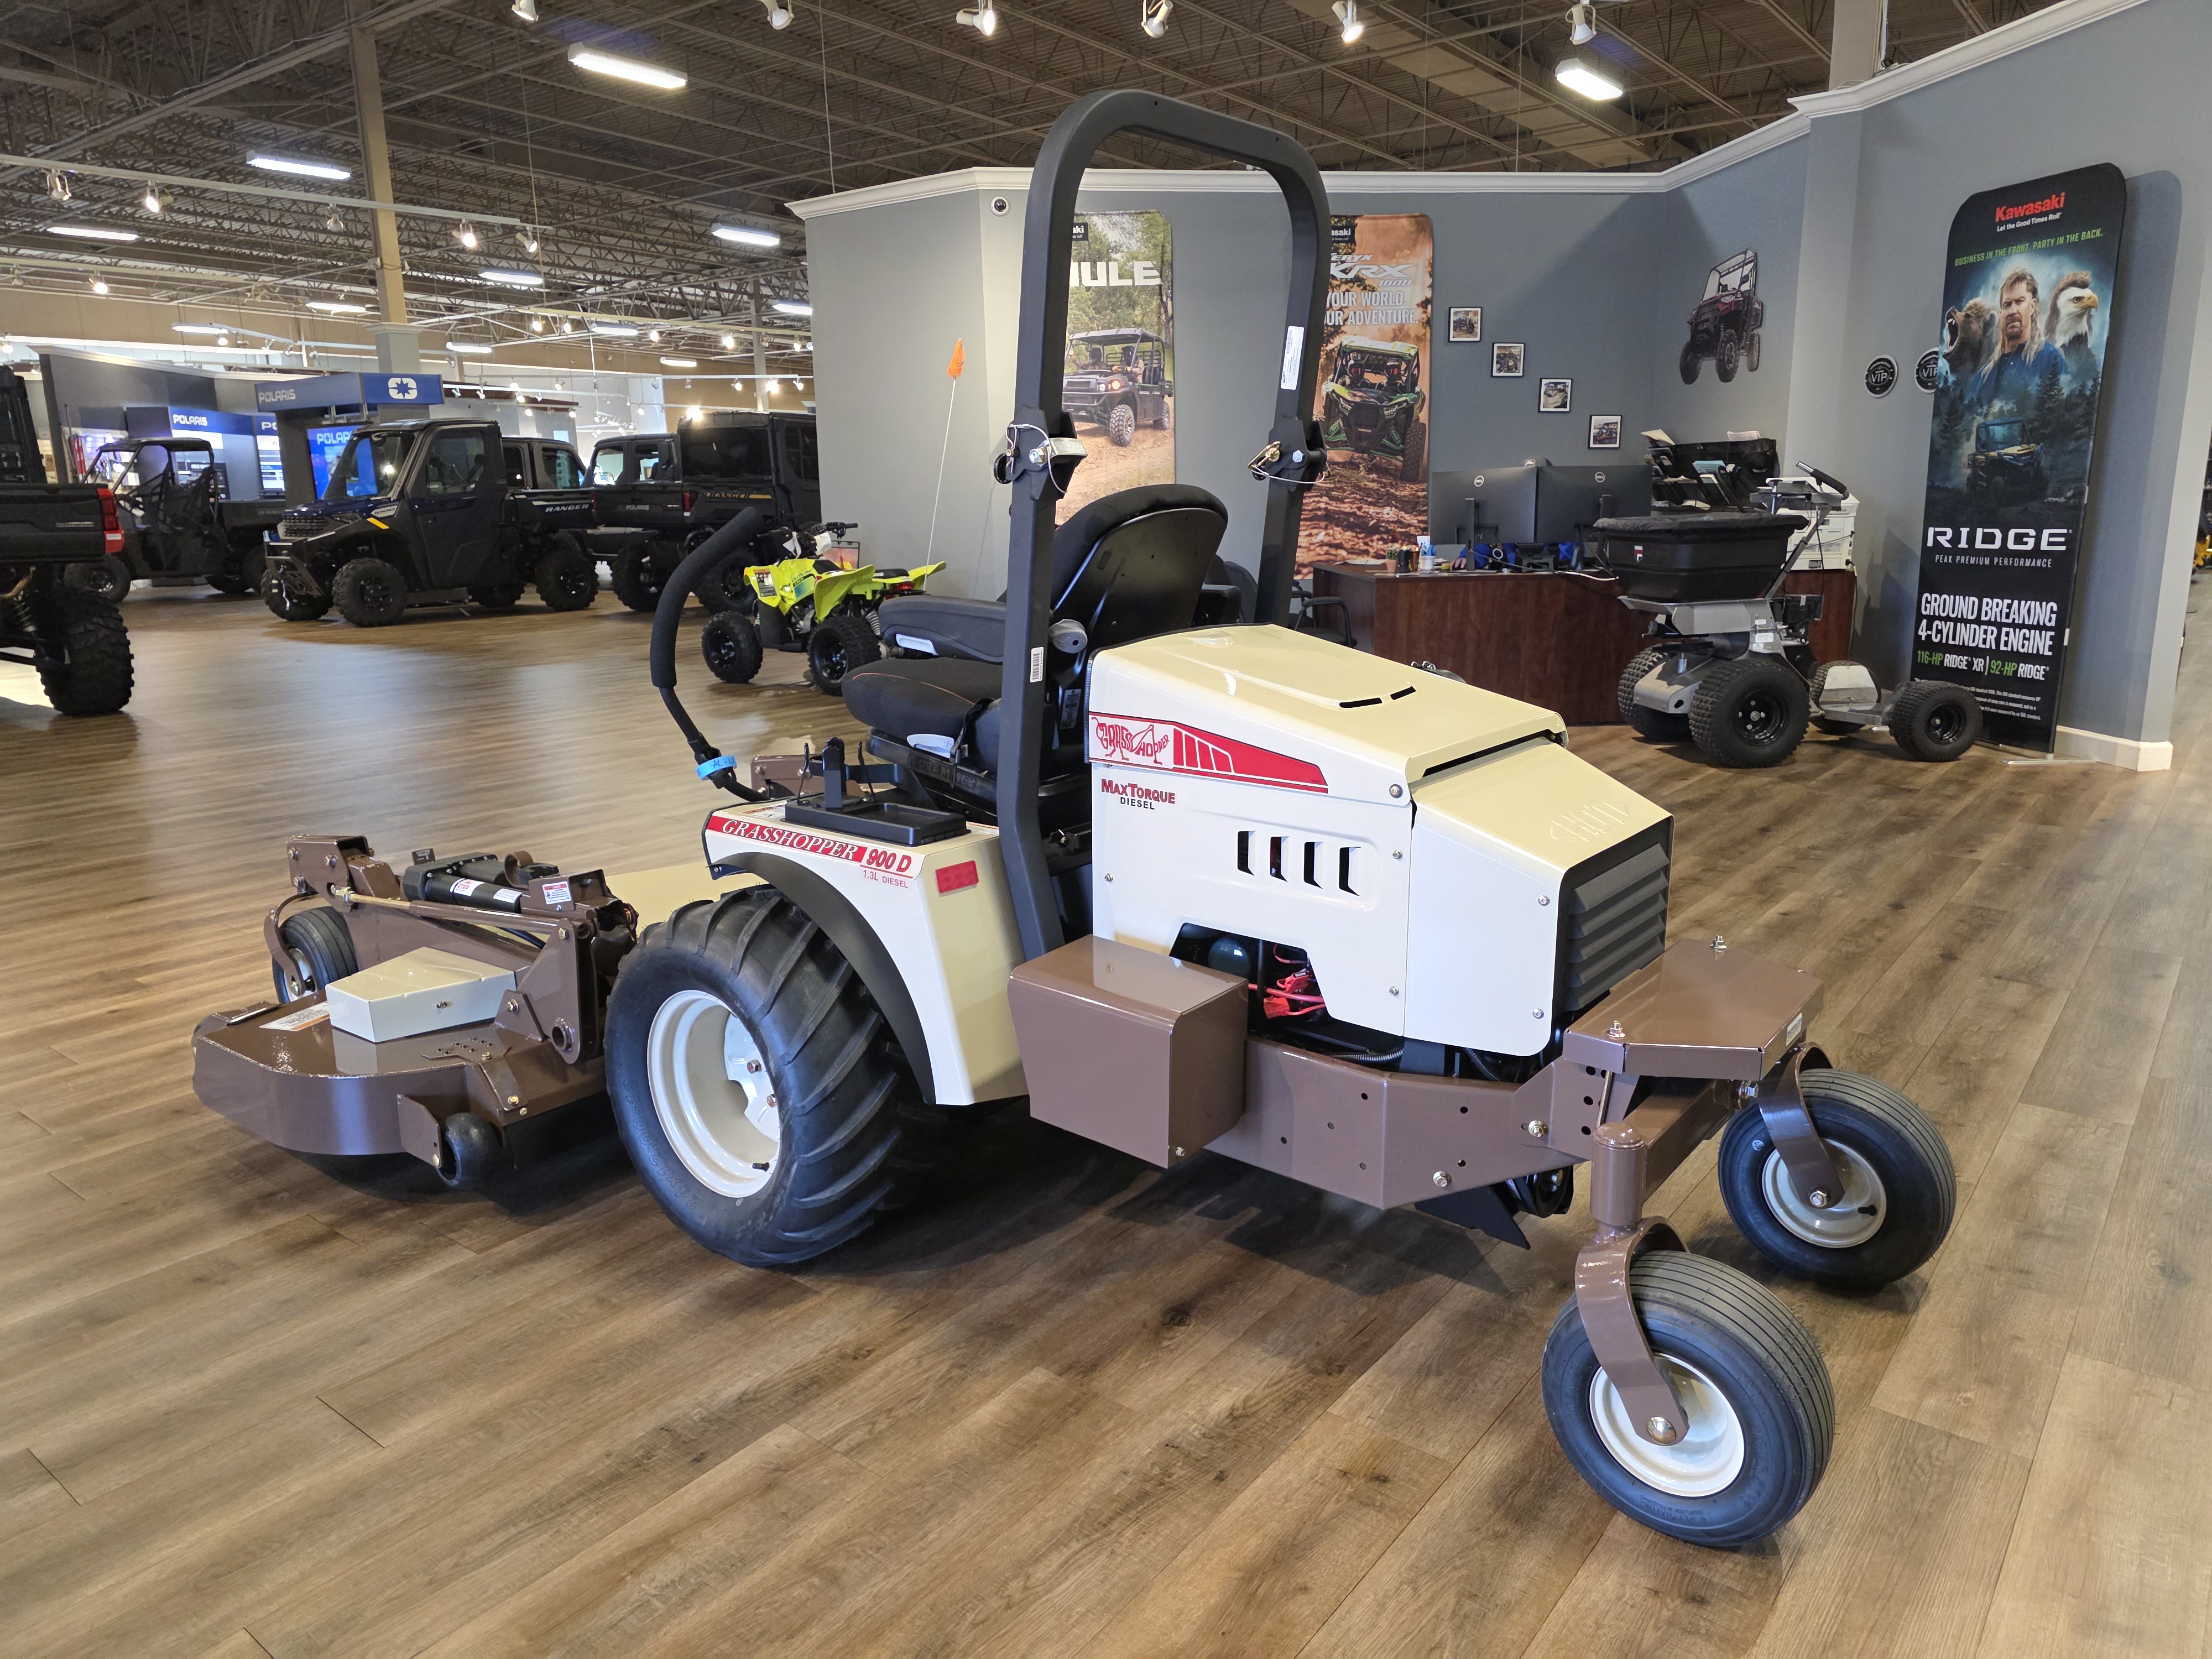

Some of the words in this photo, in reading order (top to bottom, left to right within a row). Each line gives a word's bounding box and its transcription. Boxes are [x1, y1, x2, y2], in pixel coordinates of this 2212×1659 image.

[1995, 191, 2065, 222] Kawasaki
[2016, 219, 2031, 227] Good
[2031, 216, 2047, 224] Times
[1331, 228, 1351, 236] asaki
[1955, 253, 1985, 267] BUSINESS
[1986, 251, 1994, 259] IN
[1995, 248, 2006, 258] THE
[2008, 243, 2031, 255] FRONT.
[2033, 238, 2054, 250] PARTY
[2057, 236, 2064, 246] IN
[2065, 233, 2079, 243] THE
[2081, 228, 2103, 241] BACK.
[1361, 291, 1407, 306] WORLD.
[1324, 310, 1344, 326] UR
[1348, 309, 1418, 325] ADVENTURE.
[1871, 372, 1887, 383] VIP
[258, 389, 296, 403] POLARIS
[173, 414, 207, 426] POLARIS
[316, 431, 352, 445] POLAR
[545, 504, 589, 513] RANGER
[1927, 527, 2068, 551] RIDGE
[1936, 555, 1953, 564] PEAK
[1956, 556, 1990, 565] PREMIUM
[1994, 557, 2052, 567] PERFORMANCE
[1921, 593, 1979, 619] GROUND
[1981, 598, 2058, 627] BREAKING
[1918, 619, 1997, 650] 4-CYLINDER
[2000, 627, 2055, 656] ENGINE
[1917, 650, 1943, 666] 116-HP
[1944, 654, 1969, 670] RIDGE
[1972, 657, 1984, 672] XR
[1990, 660, 2017, 676] 92-HP
[2017, 664, 2045, 680] RIDGE
[1120, 797, 1155, 810] DIESEL
[722, 820, 858, 860] GRASSHOPPER
[867, 849, 897, 869] 900
[896, 854, 912, 872] D
[863, 870, 878, 881] 1.3L
[882, 876, 909, 888] DIESEL
